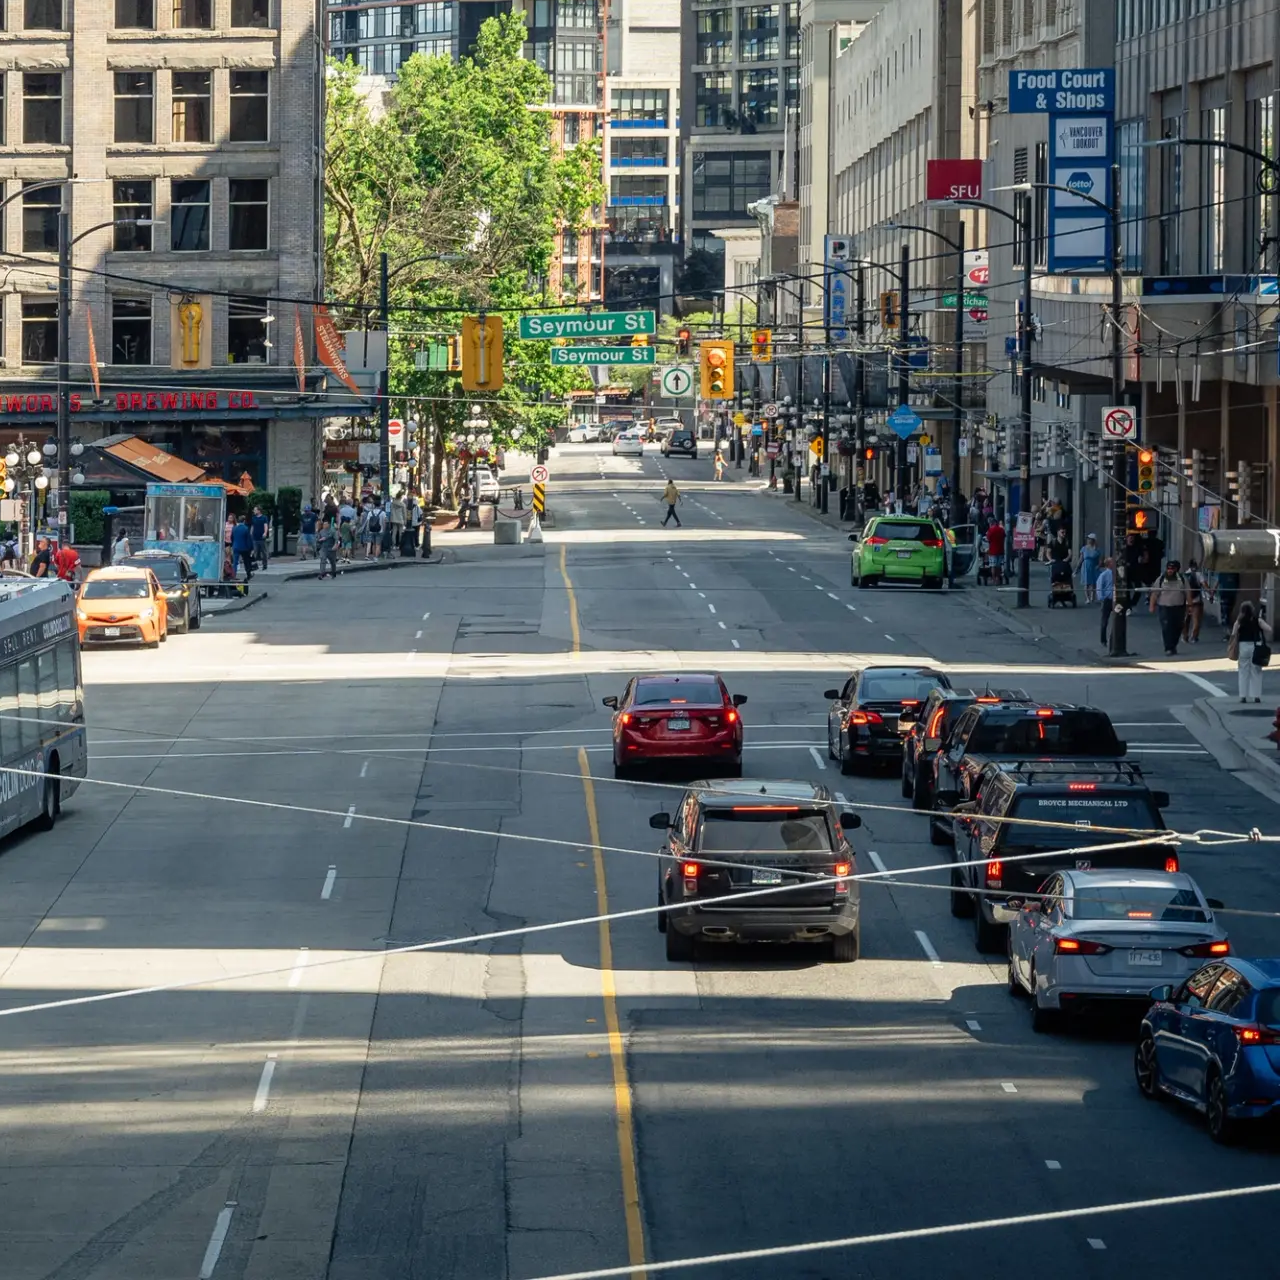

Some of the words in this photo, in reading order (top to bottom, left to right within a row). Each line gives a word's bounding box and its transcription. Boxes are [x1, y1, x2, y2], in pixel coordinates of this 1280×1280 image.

[1017, 72, 1056, 90] Food
[1061, 71, 1105, 89] Court
[1036, 93, 1047, 109] &
[1056, 92, 1105, 110] Shops
[1069, 126, 1103, 138] VANCOUVER
[1073, 138, 1099, 149] LOOKOUT
[950, 185, 980, 199] SFU
[529, 318, 615, 336] Seymour
[625, 314, 646, 330] St
[316, 325, 349, 380] STEAMWORKS
[558, 350, 625, 364] Seymour
[632, 349, 648, 361] St
[116, 391, 217, 410] BREWING
[228, 391, 259, 410] CO.
[3, 635, 19, 654] SELL
[22, 628, 37, 644] RENT
